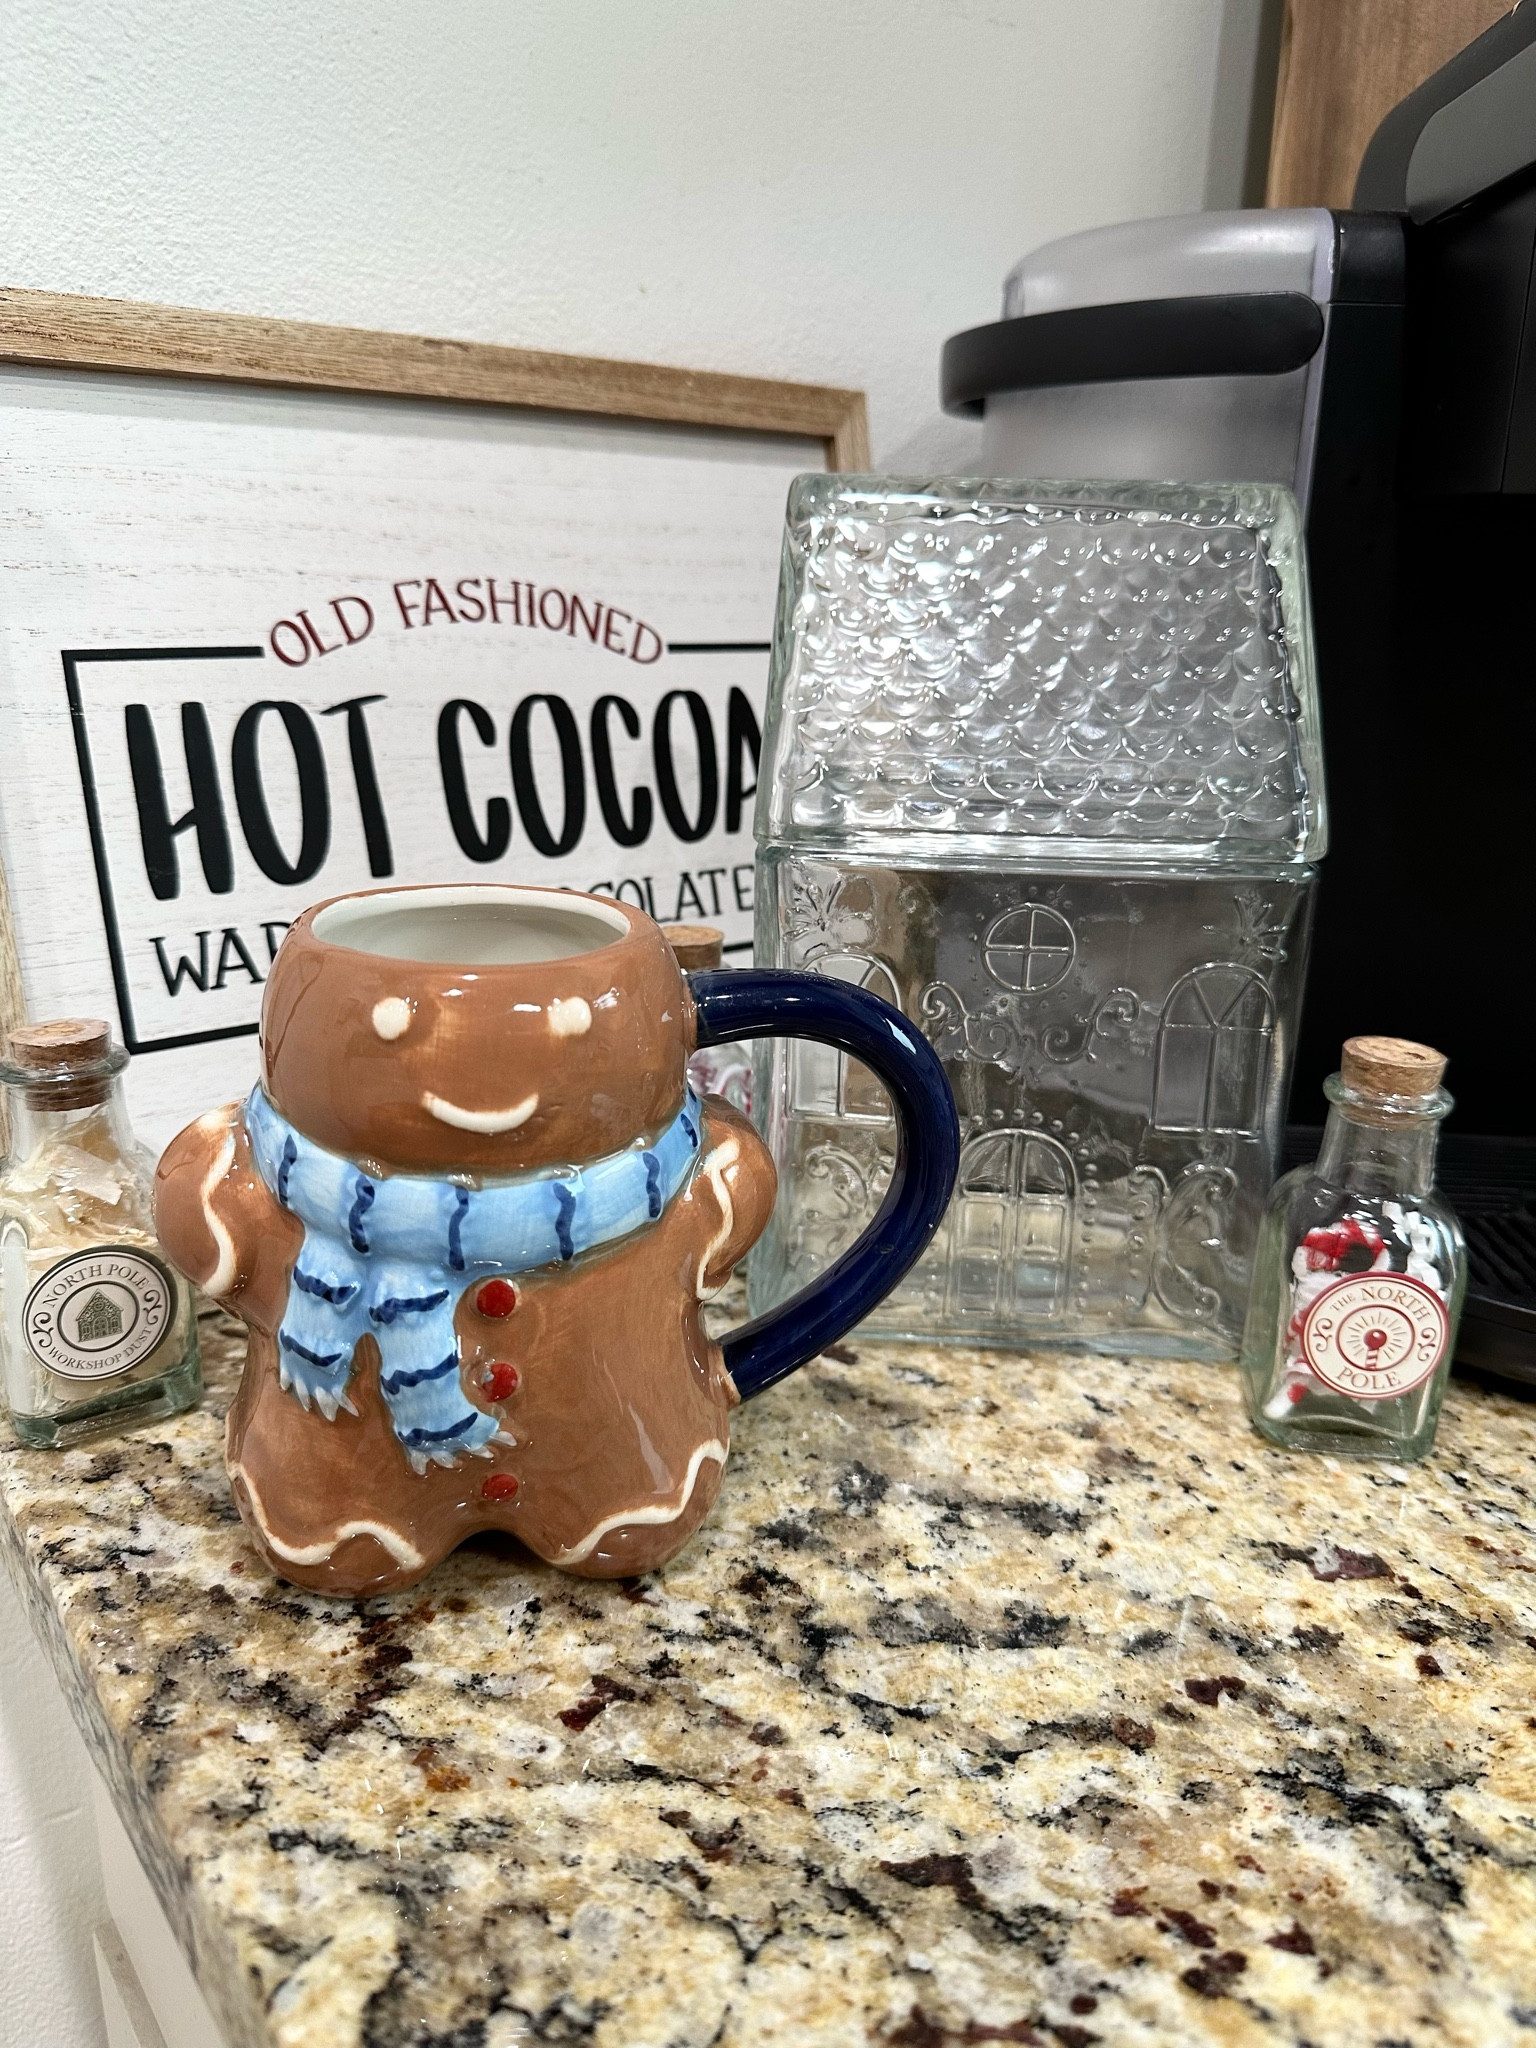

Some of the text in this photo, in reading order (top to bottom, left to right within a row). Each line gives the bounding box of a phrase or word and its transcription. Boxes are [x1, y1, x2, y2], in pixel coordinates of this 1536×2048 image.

[270, 578, 663, 668] OLD FASHIONED
[125, 686, 761, 900] HOT COCOA
[42, 1263, 149, 1308] NORTH POLE
[1330, 1286, 1431, 1322] THE NORTH
[49, 1326, 153, 1370] WORKSHOP DUST
[1336, 1365, 1400, 1389] POLE
